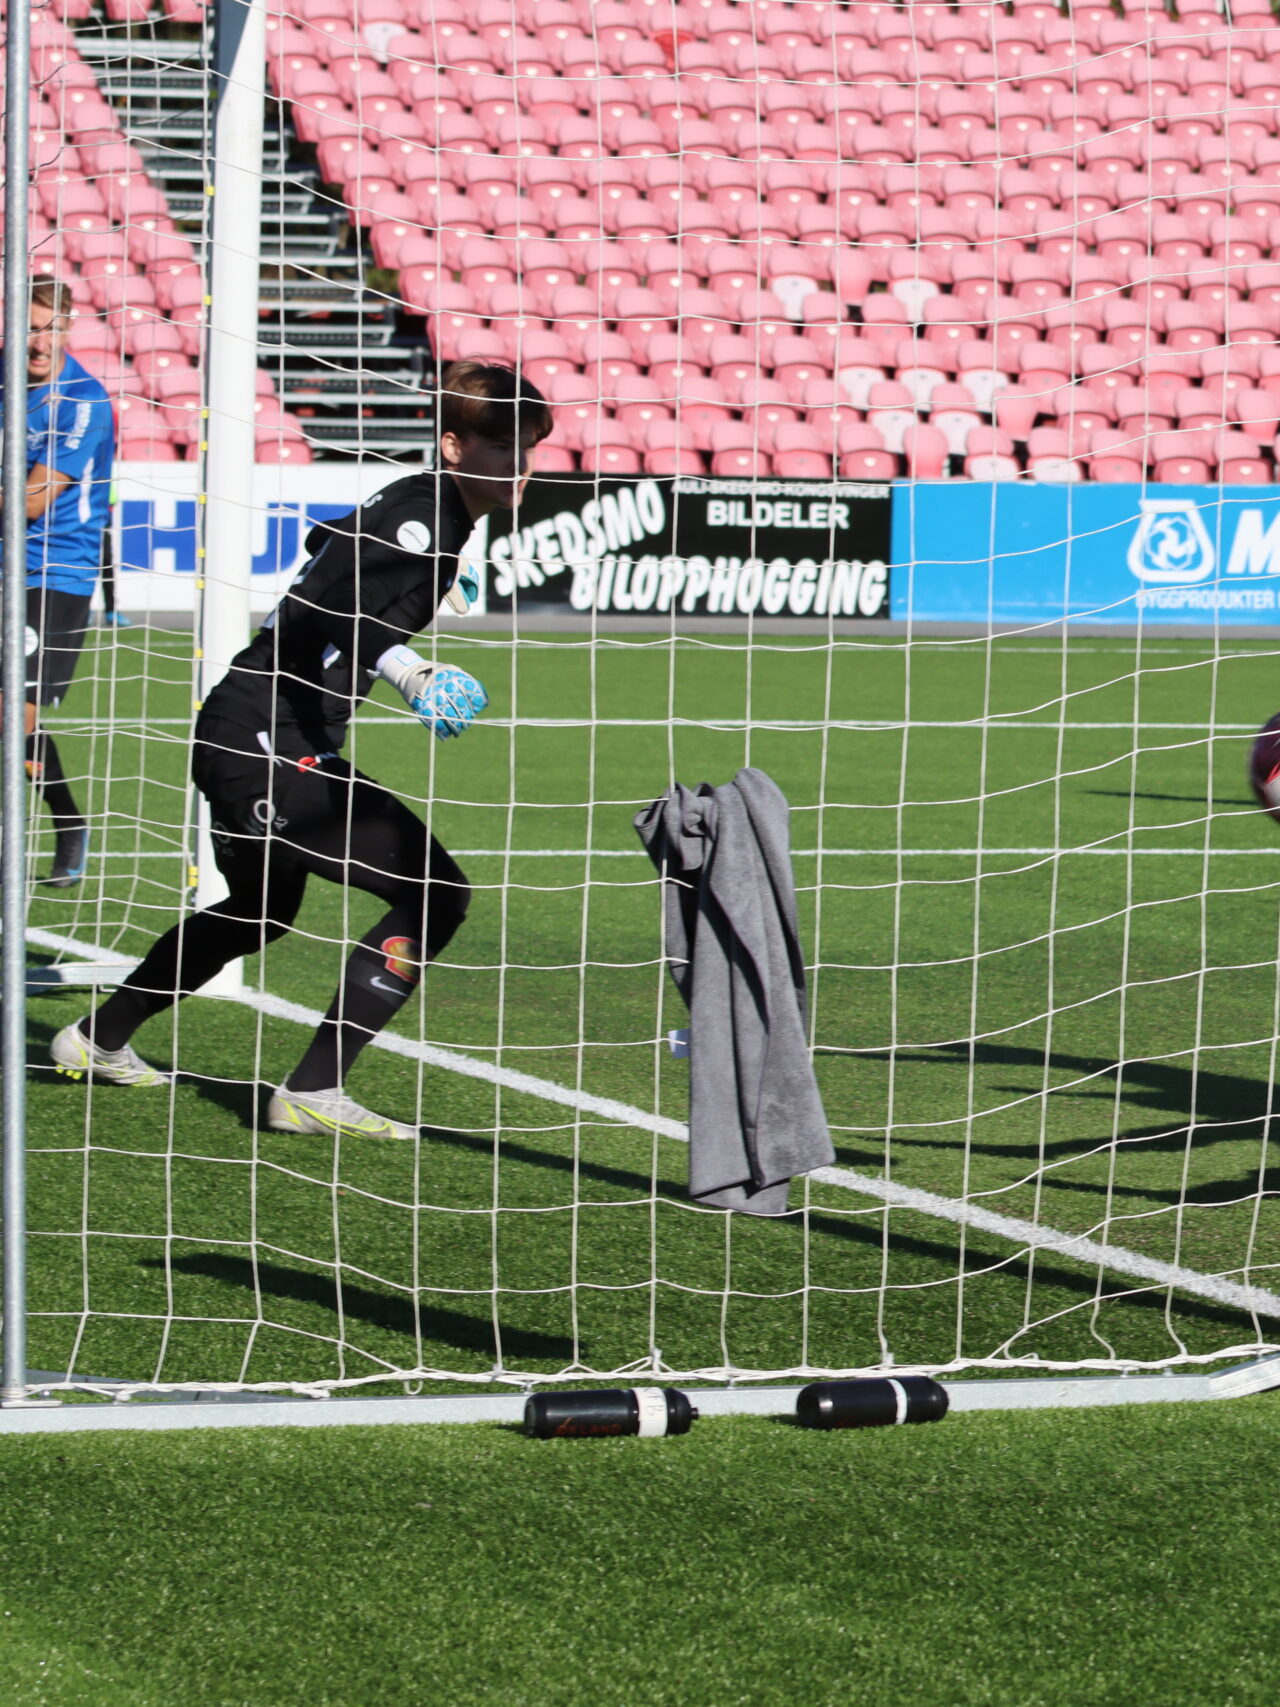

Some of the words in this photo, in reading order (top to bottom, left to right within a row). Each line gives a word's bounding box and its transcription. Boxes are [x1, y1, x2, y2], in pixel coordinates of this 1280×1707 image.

[706, 500, 850, 529] BILDELER
[490, 479, 665, 597] SKEDSMO
[1135, 589, 1274, 609] BYGGPRODUKTER
